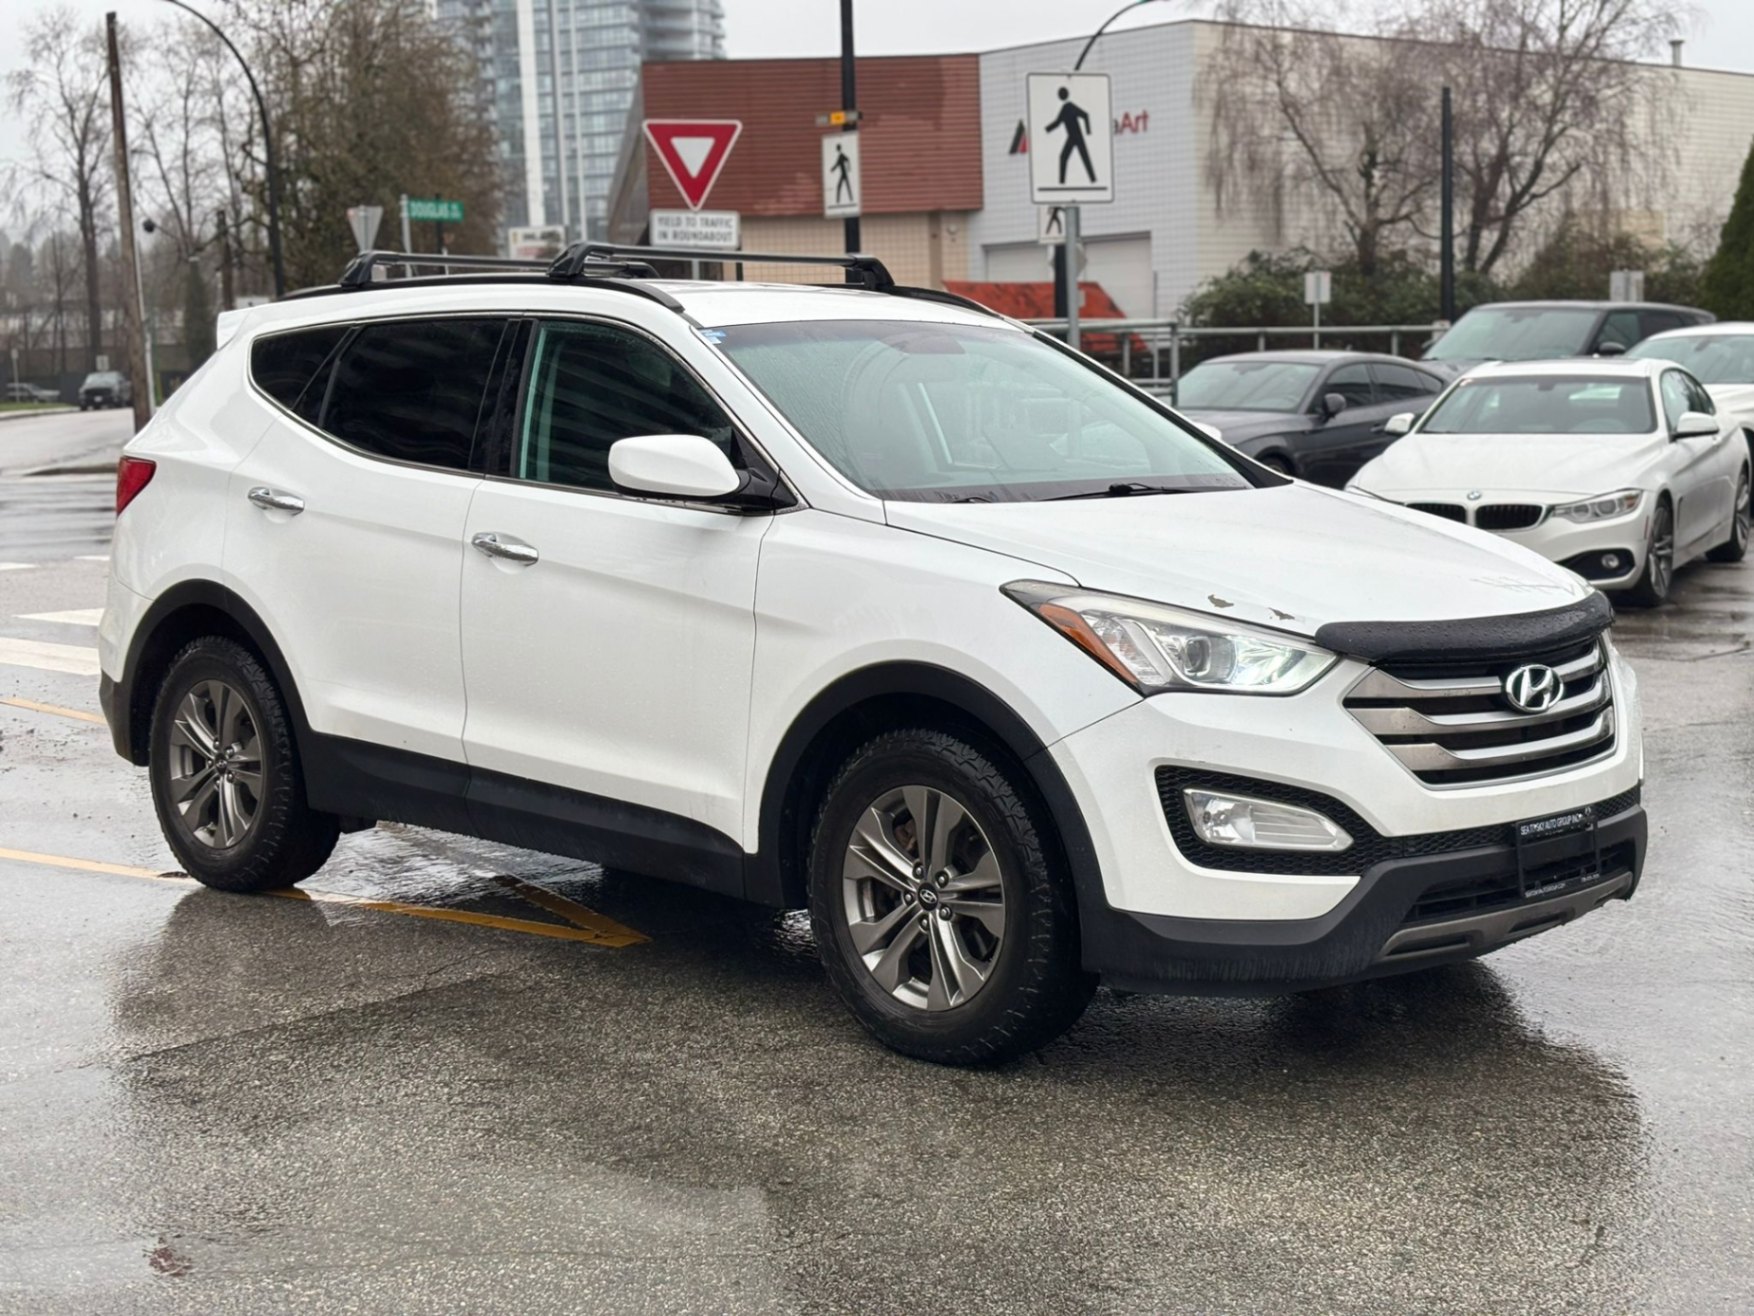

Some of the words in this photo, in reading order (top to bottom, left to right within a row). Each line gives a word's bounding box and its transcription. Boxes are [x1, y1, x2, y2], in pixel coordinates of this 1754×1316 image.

[410, 201, 449, 219] DOUGLAS
[657, 215, 682, 227] YIELD
[685, 216, 697, 228] TO
[699, 217, 733, 229] TRAFFIC
[658, 230, 668, 241] IN
[672, 230, 733, 243] ROUNDABOUT
[1545, 818, 1557, 830] AUTO
[1557, 815, 1572, 828] GROUP
